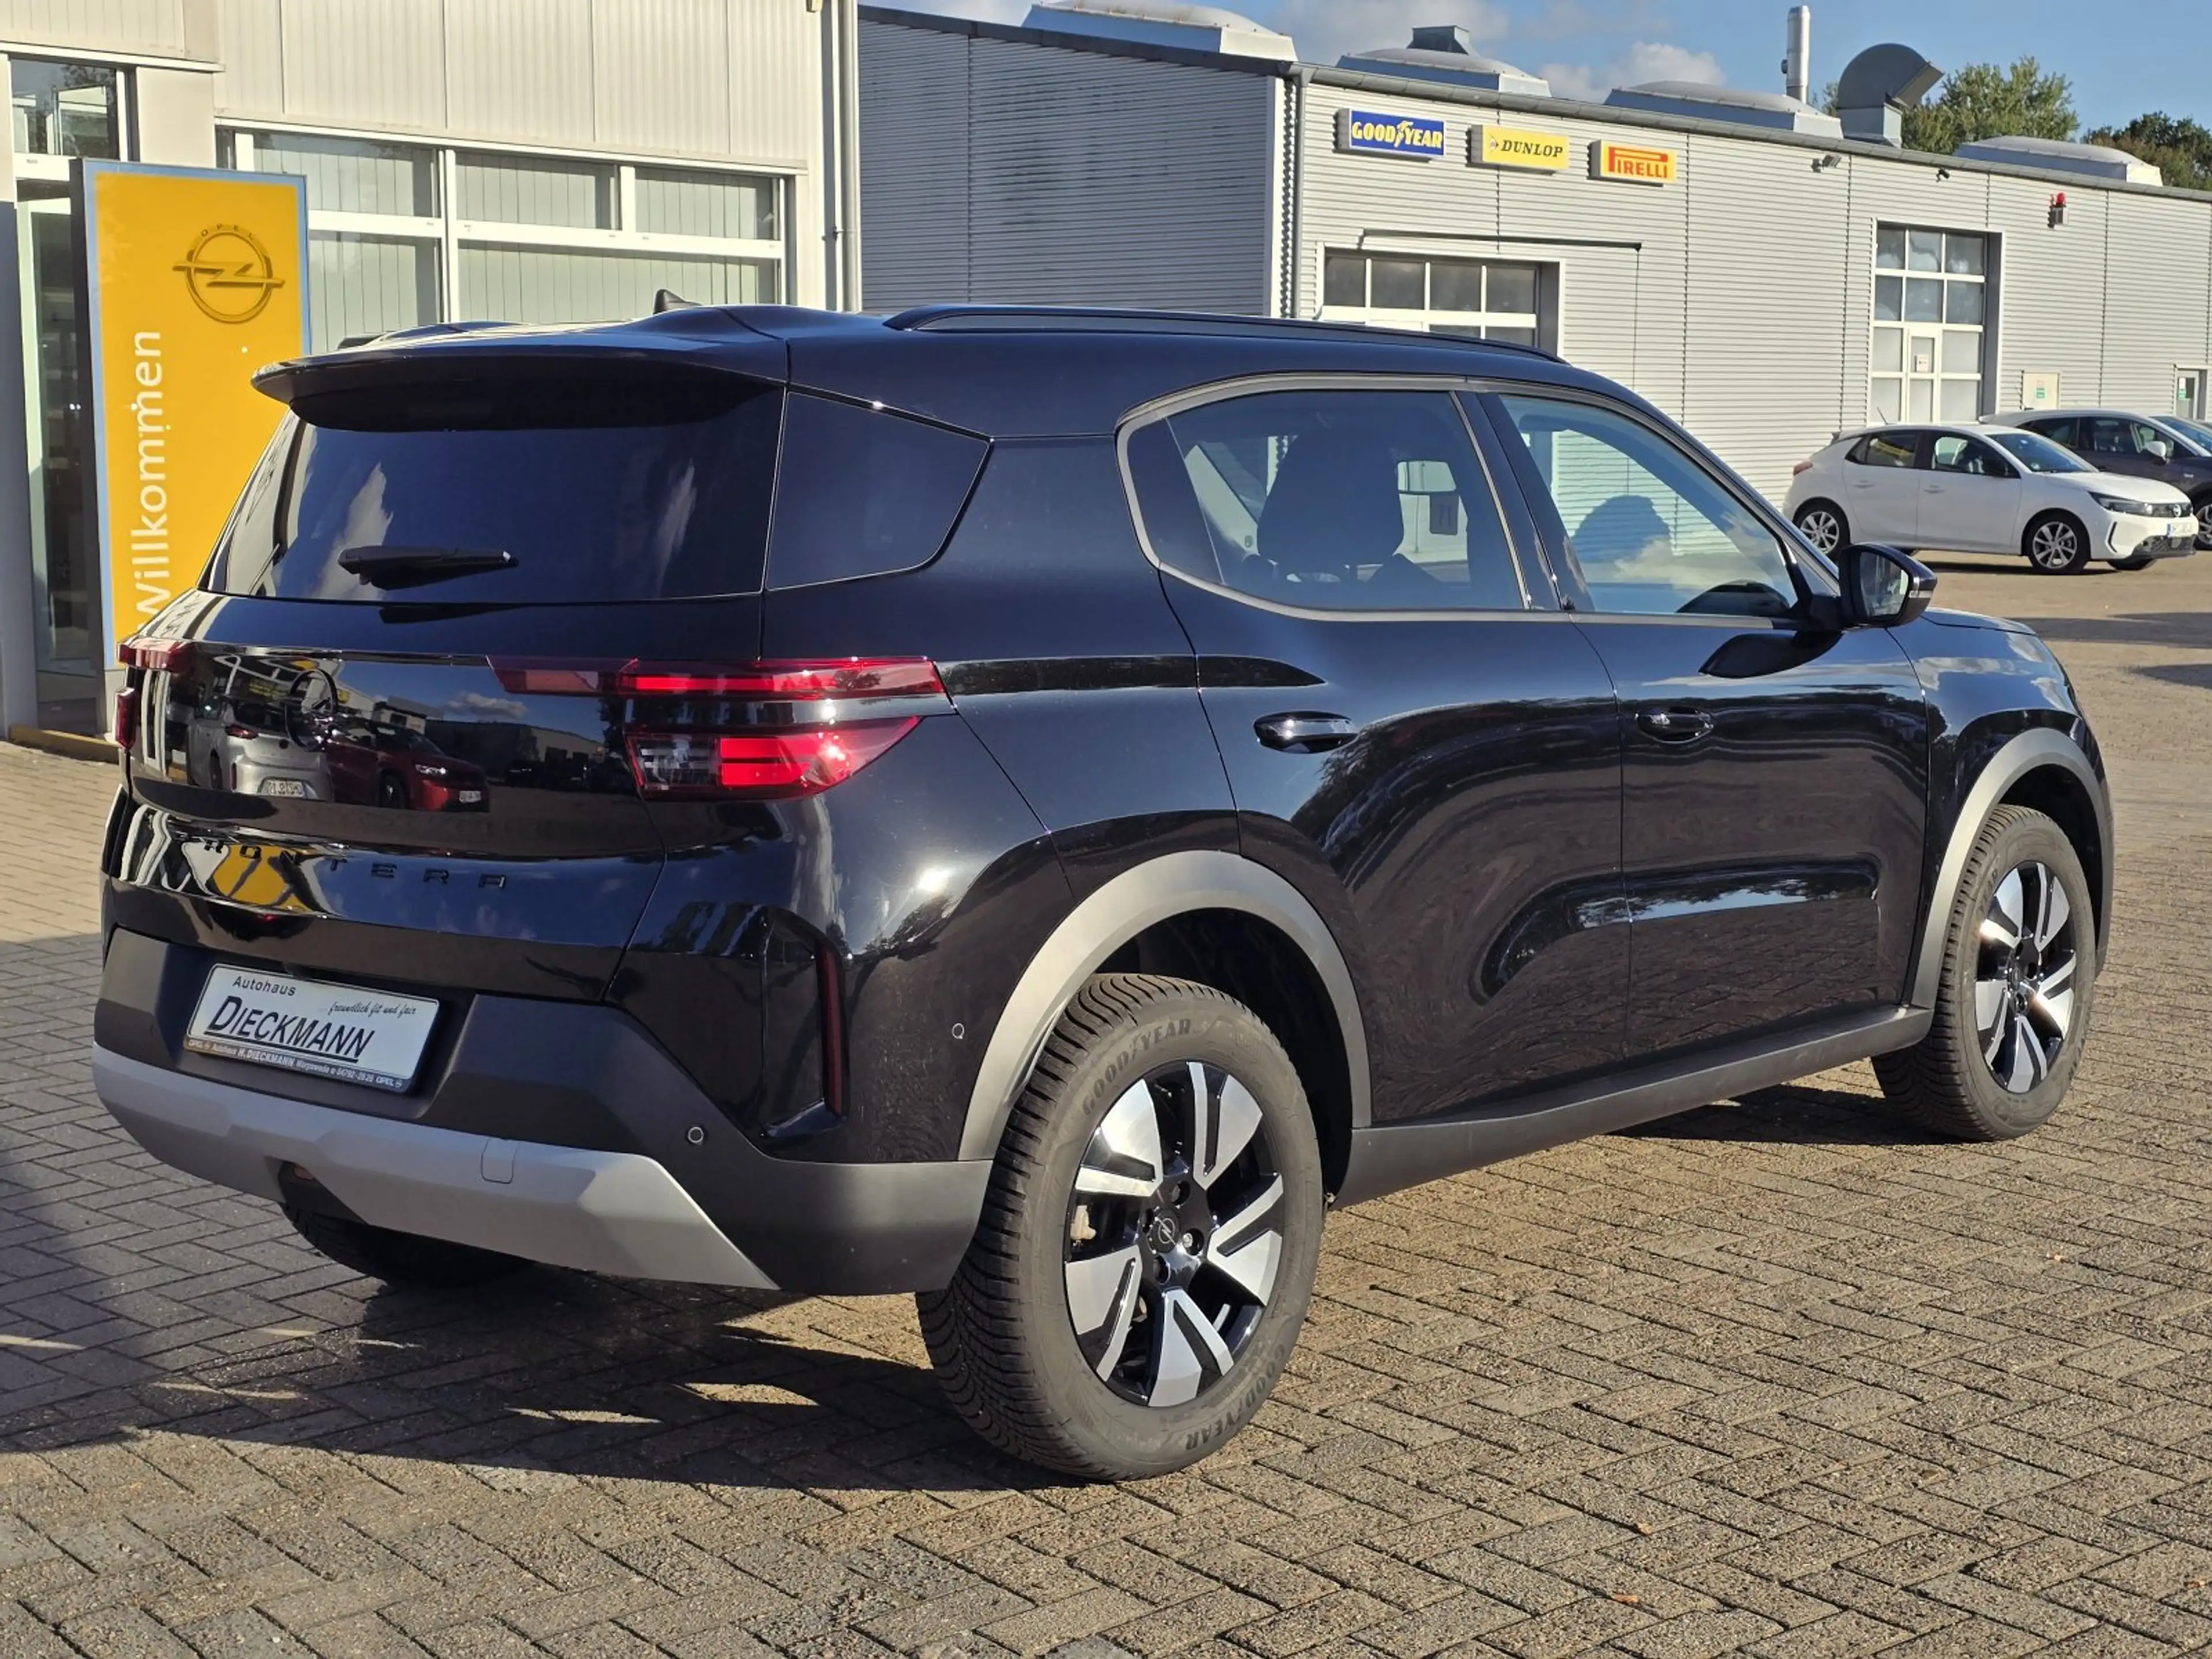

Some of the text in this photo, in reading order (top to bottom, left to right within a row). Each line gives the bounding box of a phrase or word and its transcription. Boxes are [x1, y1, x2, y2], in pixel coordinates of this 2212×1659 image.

[1501, 139, 1563, 158] DUNLOP
[1608, 146, 1668, 179] PIRELLI
[200, 223, 255, 241] OPEL
[131, 331, 172, 631] Willkommen
[233, 976, 297, 997] Autohaus
[207, 995, 376, 1058] DIECKMANN
